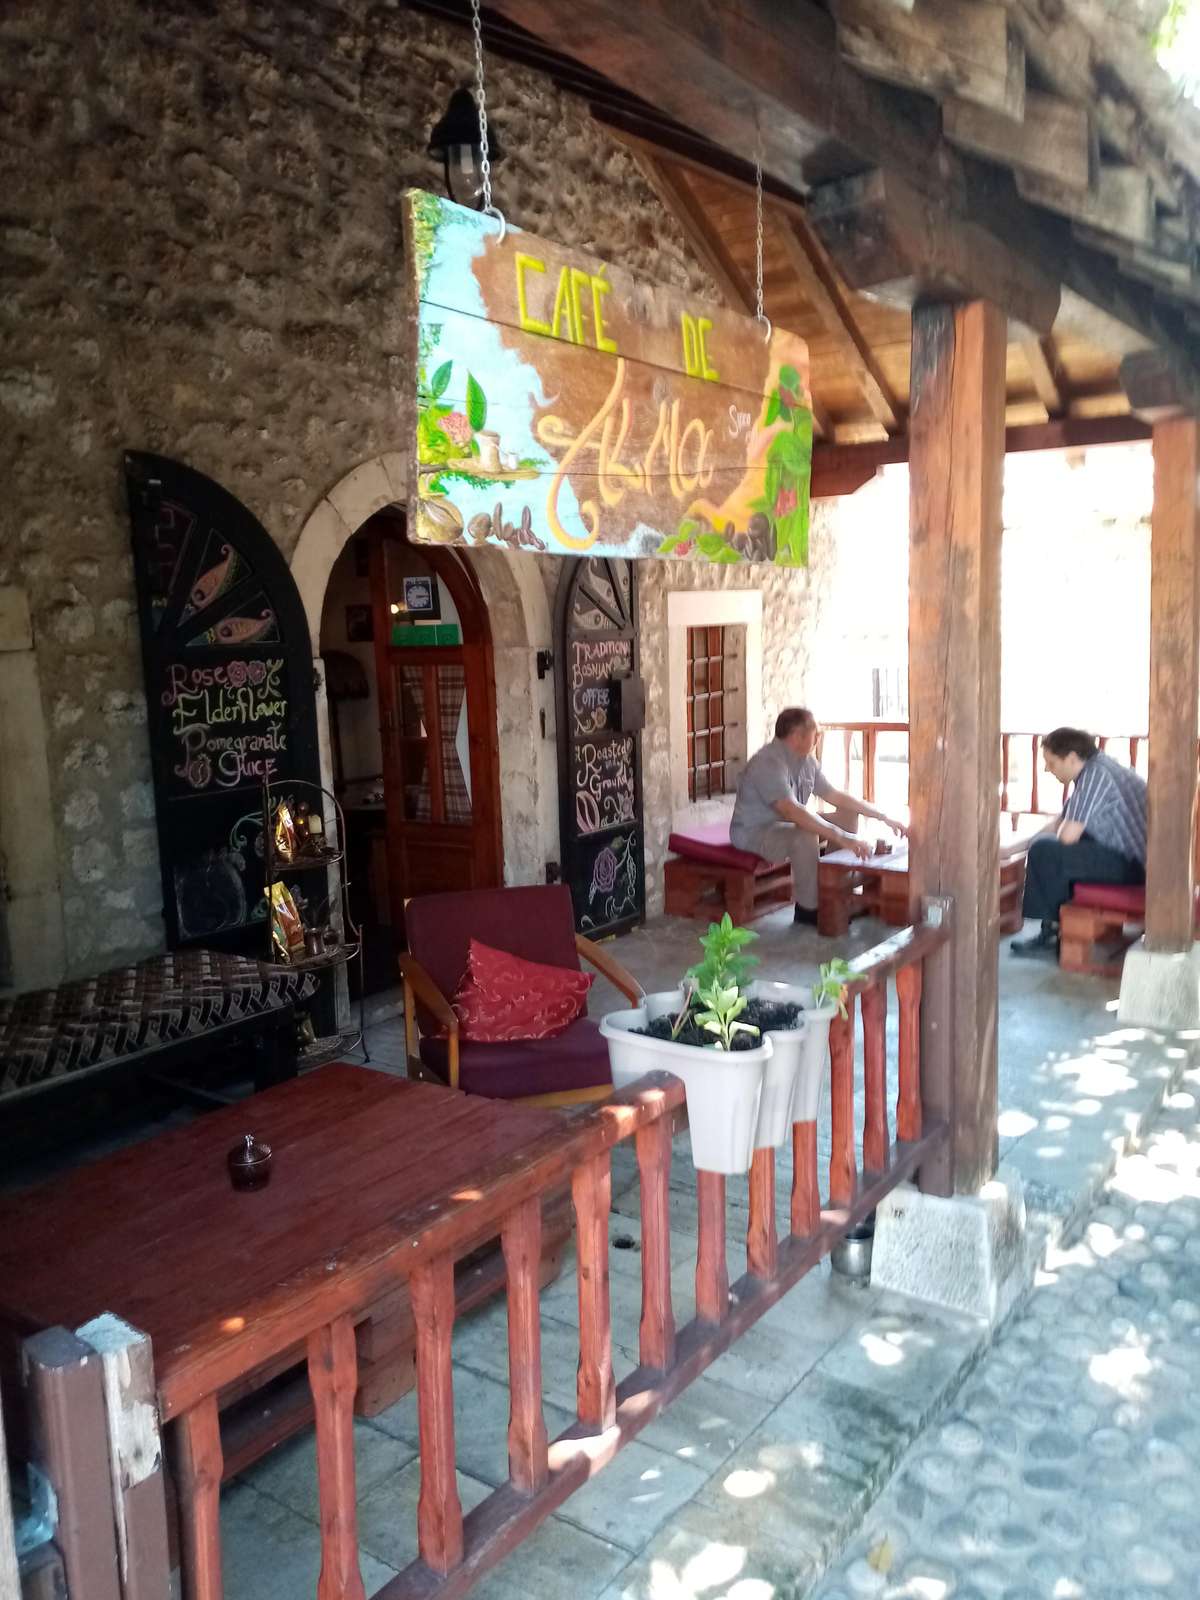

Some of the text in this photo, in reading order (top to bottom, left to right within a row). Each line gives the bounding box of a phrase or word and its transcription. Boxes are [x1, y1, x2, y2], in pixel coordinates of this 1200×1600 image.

[515, 251, 720, 381] CAFÉ DE
[161, 663, 228, 706] Rose
[172, 688, 287, 735] Elderflower
[174, 722, 287, 778] Pomegranate
[577, 739, 626, 787] Roasted
[590, 763, 627, 801] Ground
